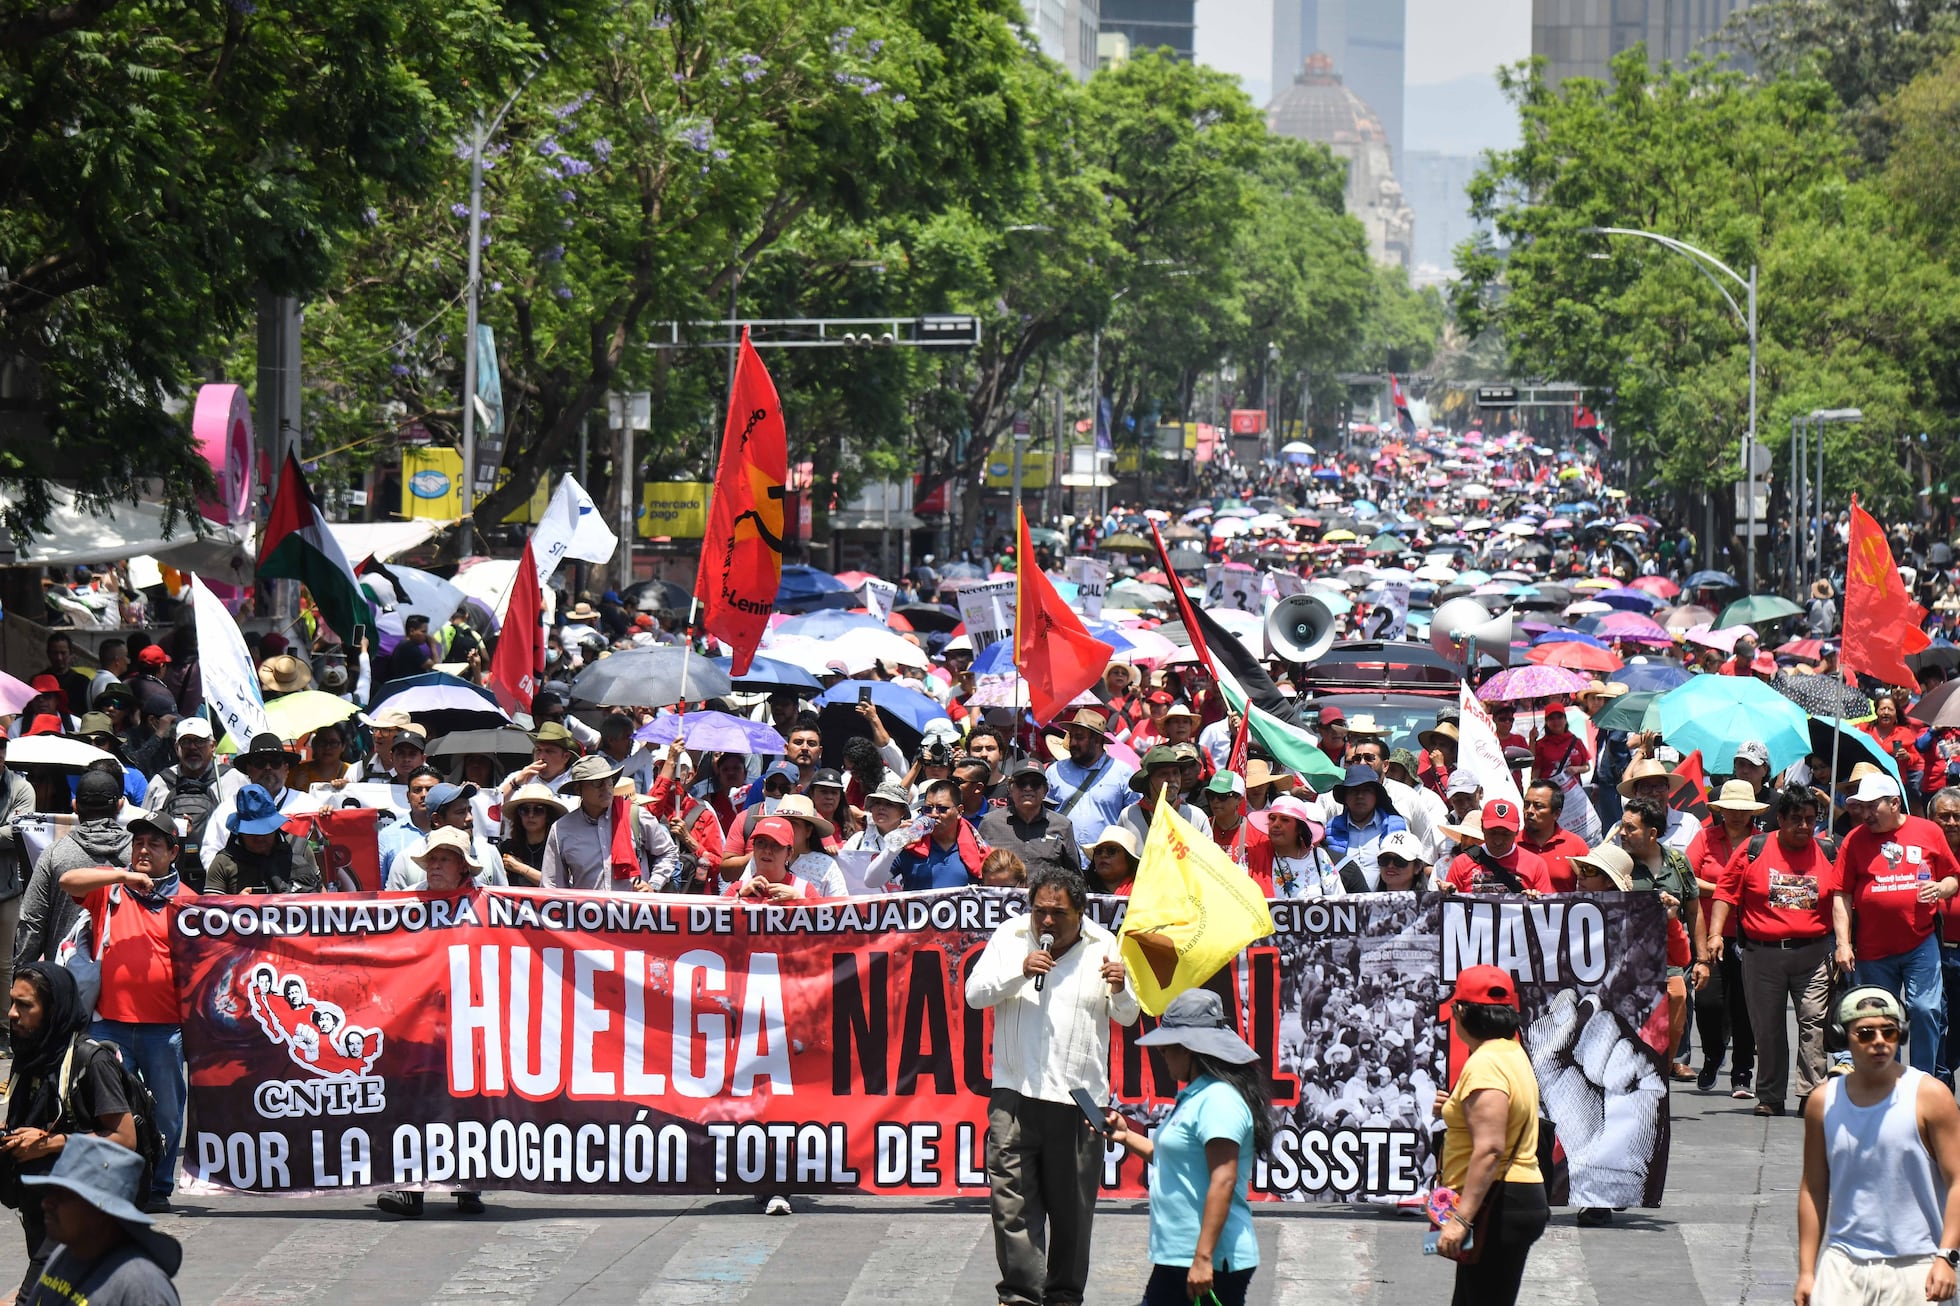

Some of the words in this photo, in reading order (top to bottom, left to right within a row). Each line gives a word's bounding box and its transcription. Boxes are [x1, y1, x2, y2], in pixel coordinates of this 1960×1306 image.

[650, 500, 700, 509] mercado
[650, 510, 679, 521] pago
[1371, 606, 1394, 640] 2
[177, 896, 480, 937] COORDINADORA
[490, 898, 676, 932] NACIONAL
[691, 906, 732, 933] DE
[745, 900, 1025, 934] TRABAJADORES
[1443, 901, 1606, 983] MAYO
[448, 944, 794, 1100] HUELGA
[255, 1078, 384, 1116] CNTE
[198, 1130, 291, 1189] POR
[311, 1126, 372, 1187] LA
[393, 1109, 688, 1184] ABROGACIÓN
[708, 1123, 857, 1184] TOTAL
[878, 1125, 938, 1184] DE
[959, 1125, 990, 1184] L
